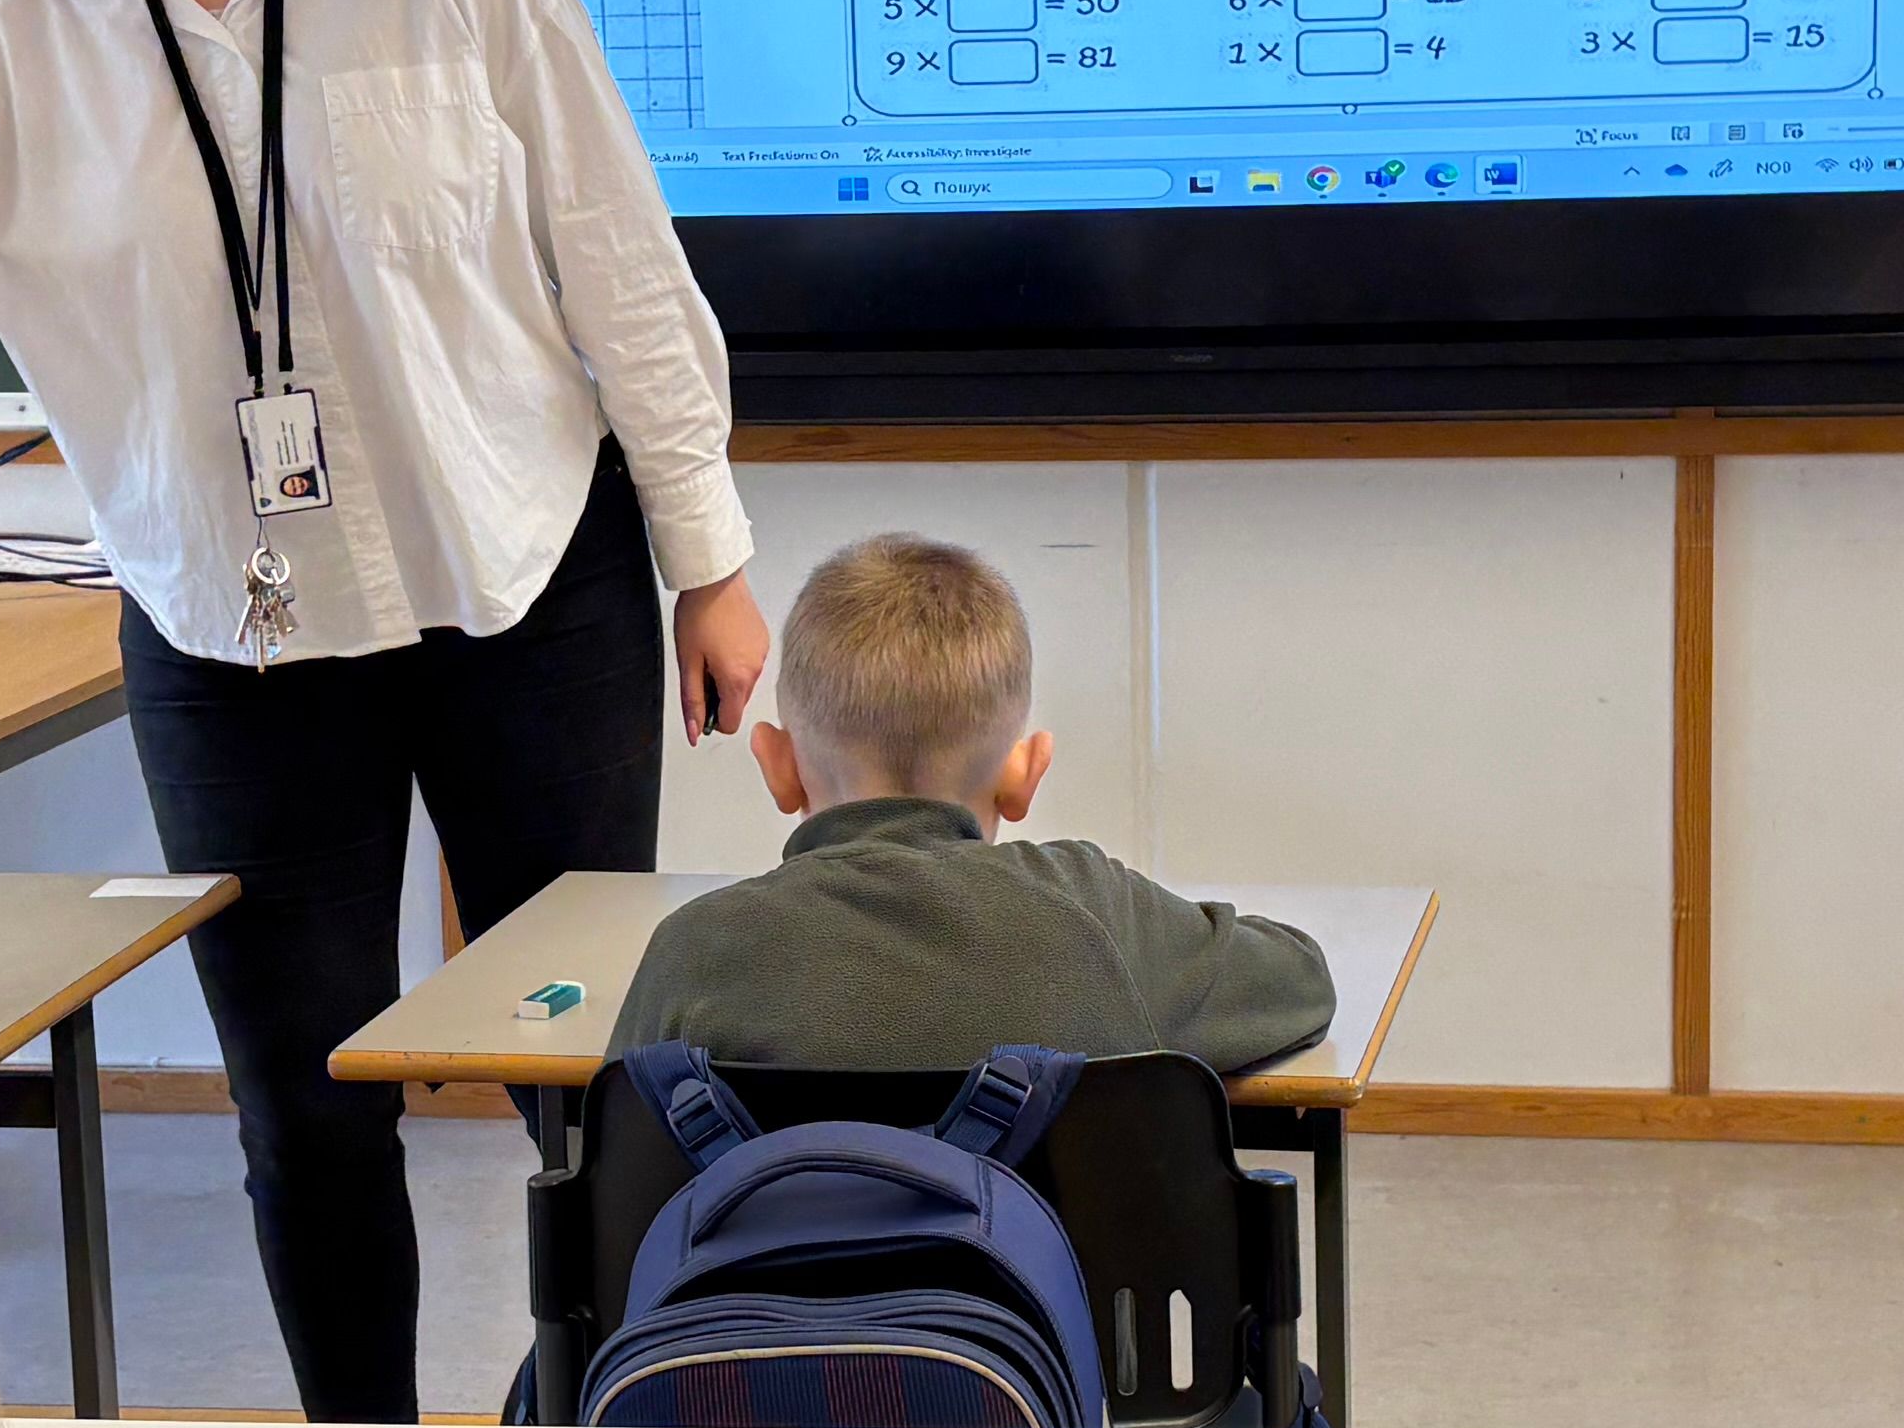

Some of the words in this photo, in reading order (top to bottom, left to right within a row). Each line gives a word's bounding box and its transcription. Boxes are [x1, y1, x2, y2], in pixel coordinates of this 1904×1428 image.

[1227, 41, 1248, 65] 1
[1426, 35, 1447, 60] 4
[1579, 30, 1601, 55] 3
[1786, 23, 1826, 50] 15
[885, 51, 906, 76] 9
[1077, 45, 1118, 70] 81
[1601, 129, 1639, 143] Focus
[934, 179, 992, 198] Пошук
